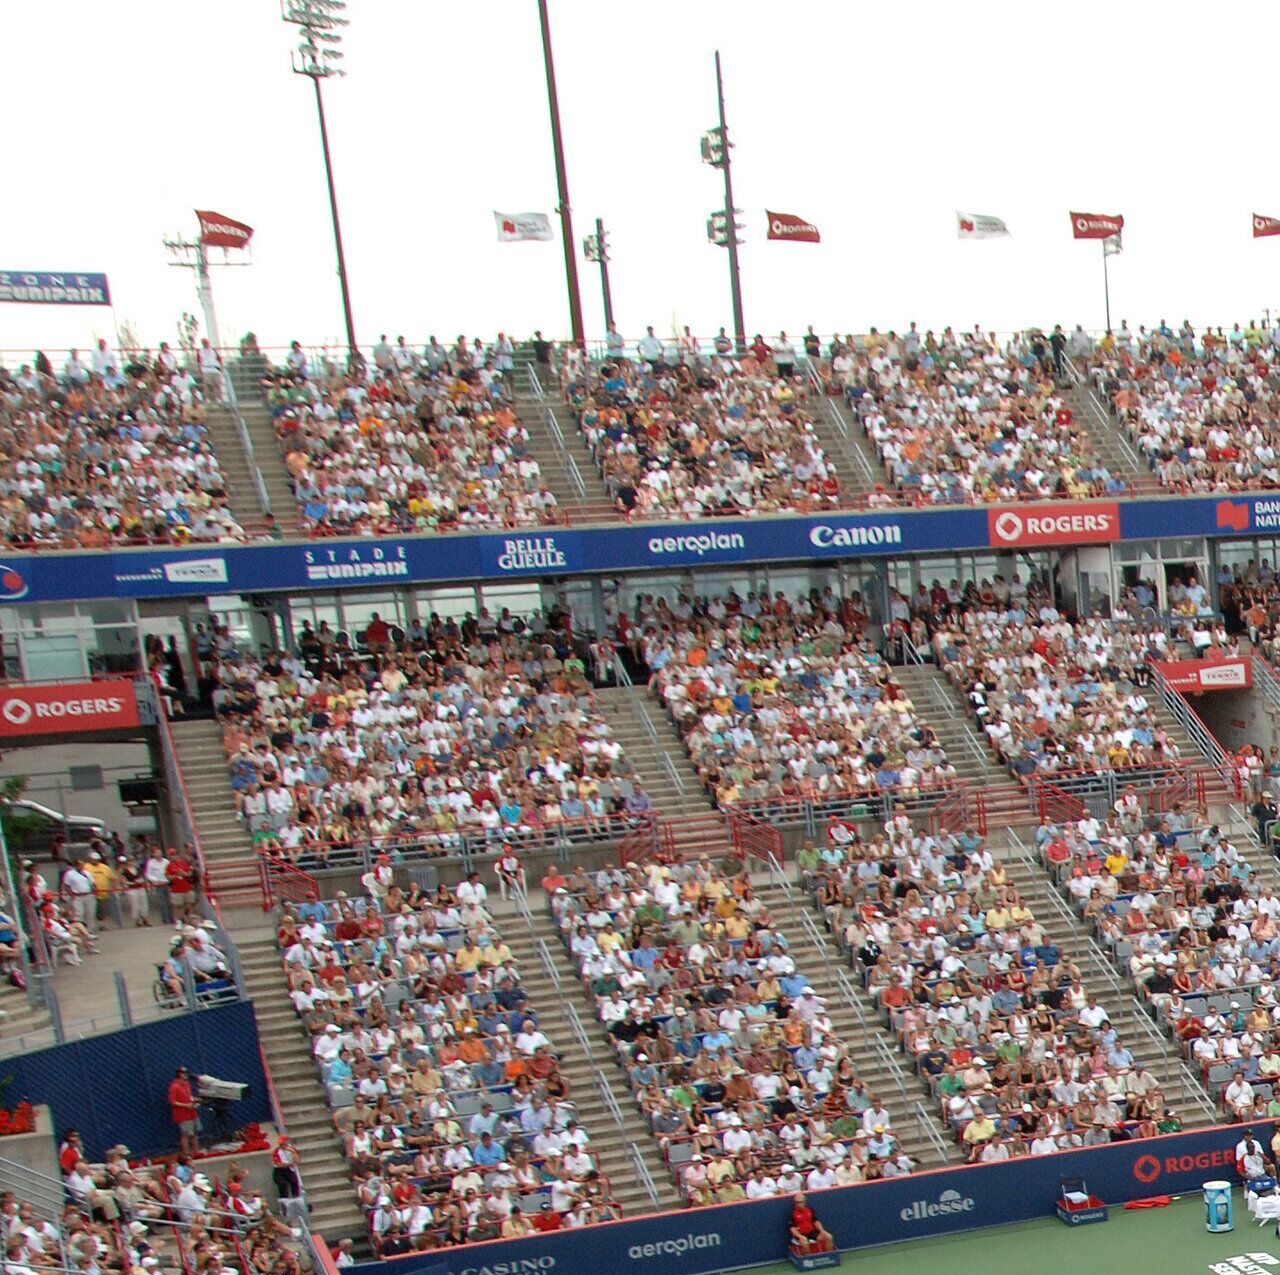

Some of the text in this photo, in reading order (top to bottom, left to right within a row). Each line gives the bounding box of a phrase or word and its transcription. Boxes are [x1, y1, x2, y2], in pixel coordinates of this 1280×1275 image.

[1027, 514, 1110, 534] ROGERS
[505, 538, 556, 554] BELLE
[648, 531, 745, 556] aeroplan
[810, 525, 902, 548] Canon
[305, 546, 406, 564] STADE
[499, 551, 566, 570] GUEULE
[35, 697, 122, 718] ROGERS
[1165, 1149, 1236, 1173] ROGER
[900, 1197, 975, 1221] ellesse
[629, 1232, 720, 1260] aeroplan
